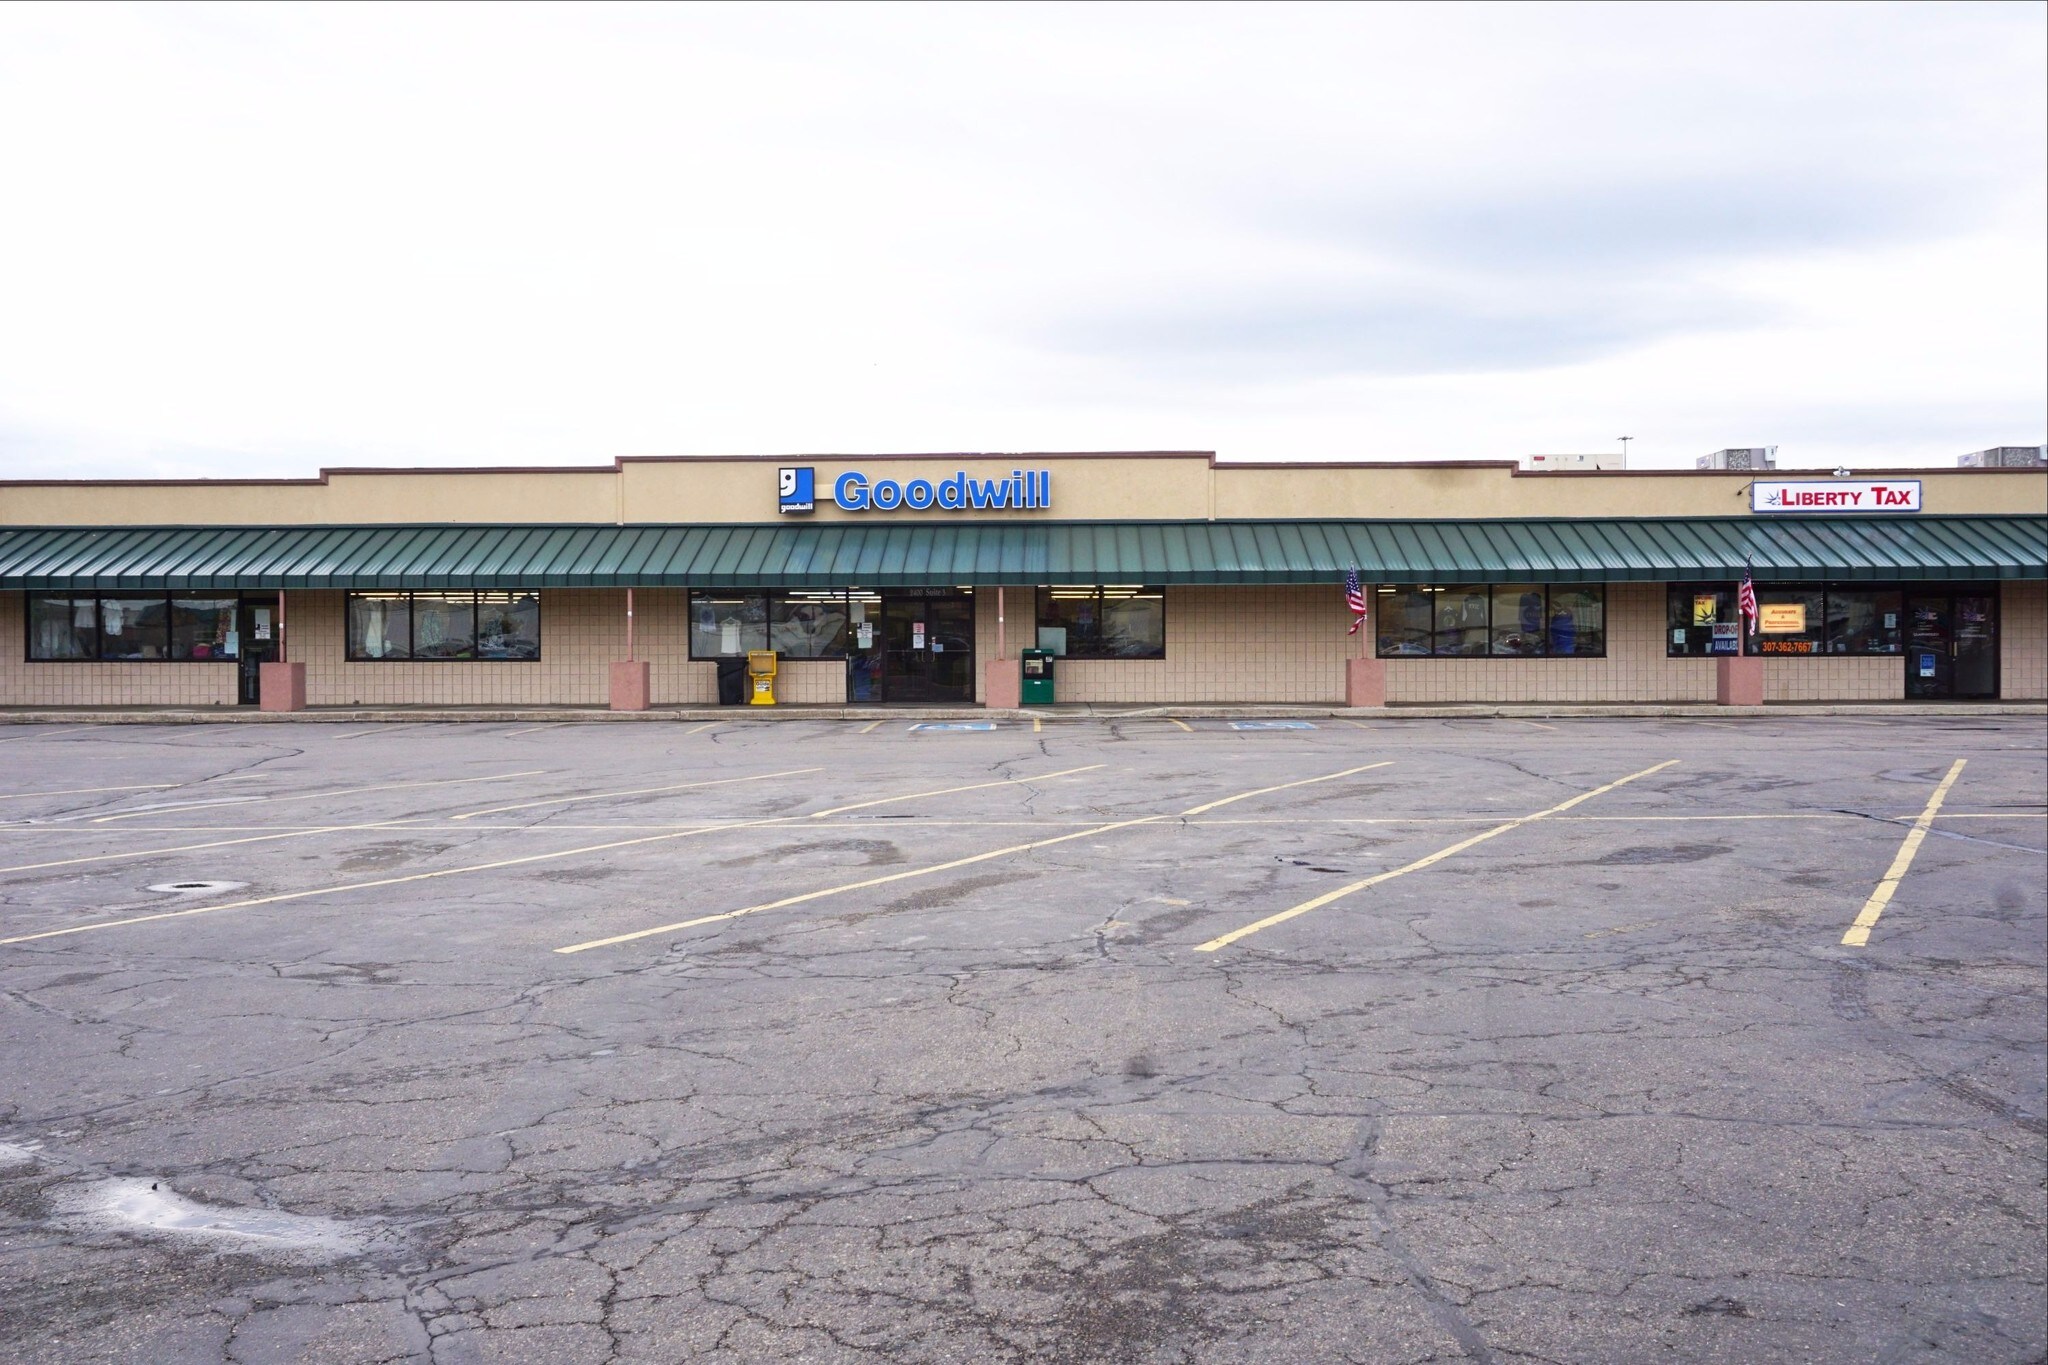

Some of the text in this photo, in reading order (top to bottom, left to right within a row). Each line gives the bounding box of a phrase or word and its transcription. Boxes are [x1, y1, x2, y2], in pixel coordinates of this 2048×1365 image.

[833, 470, 1050, 510] Goodwill
[1782, 487, 1911, 506] LIBERTY TAX
[781, 503, 813, 514] goodwill
[1714, 624, 1738, 635] DROP-OF
[1714, 640, 1738, 650] AVAILAB
[1763, 641, 1812, 652] 307-362-7667
